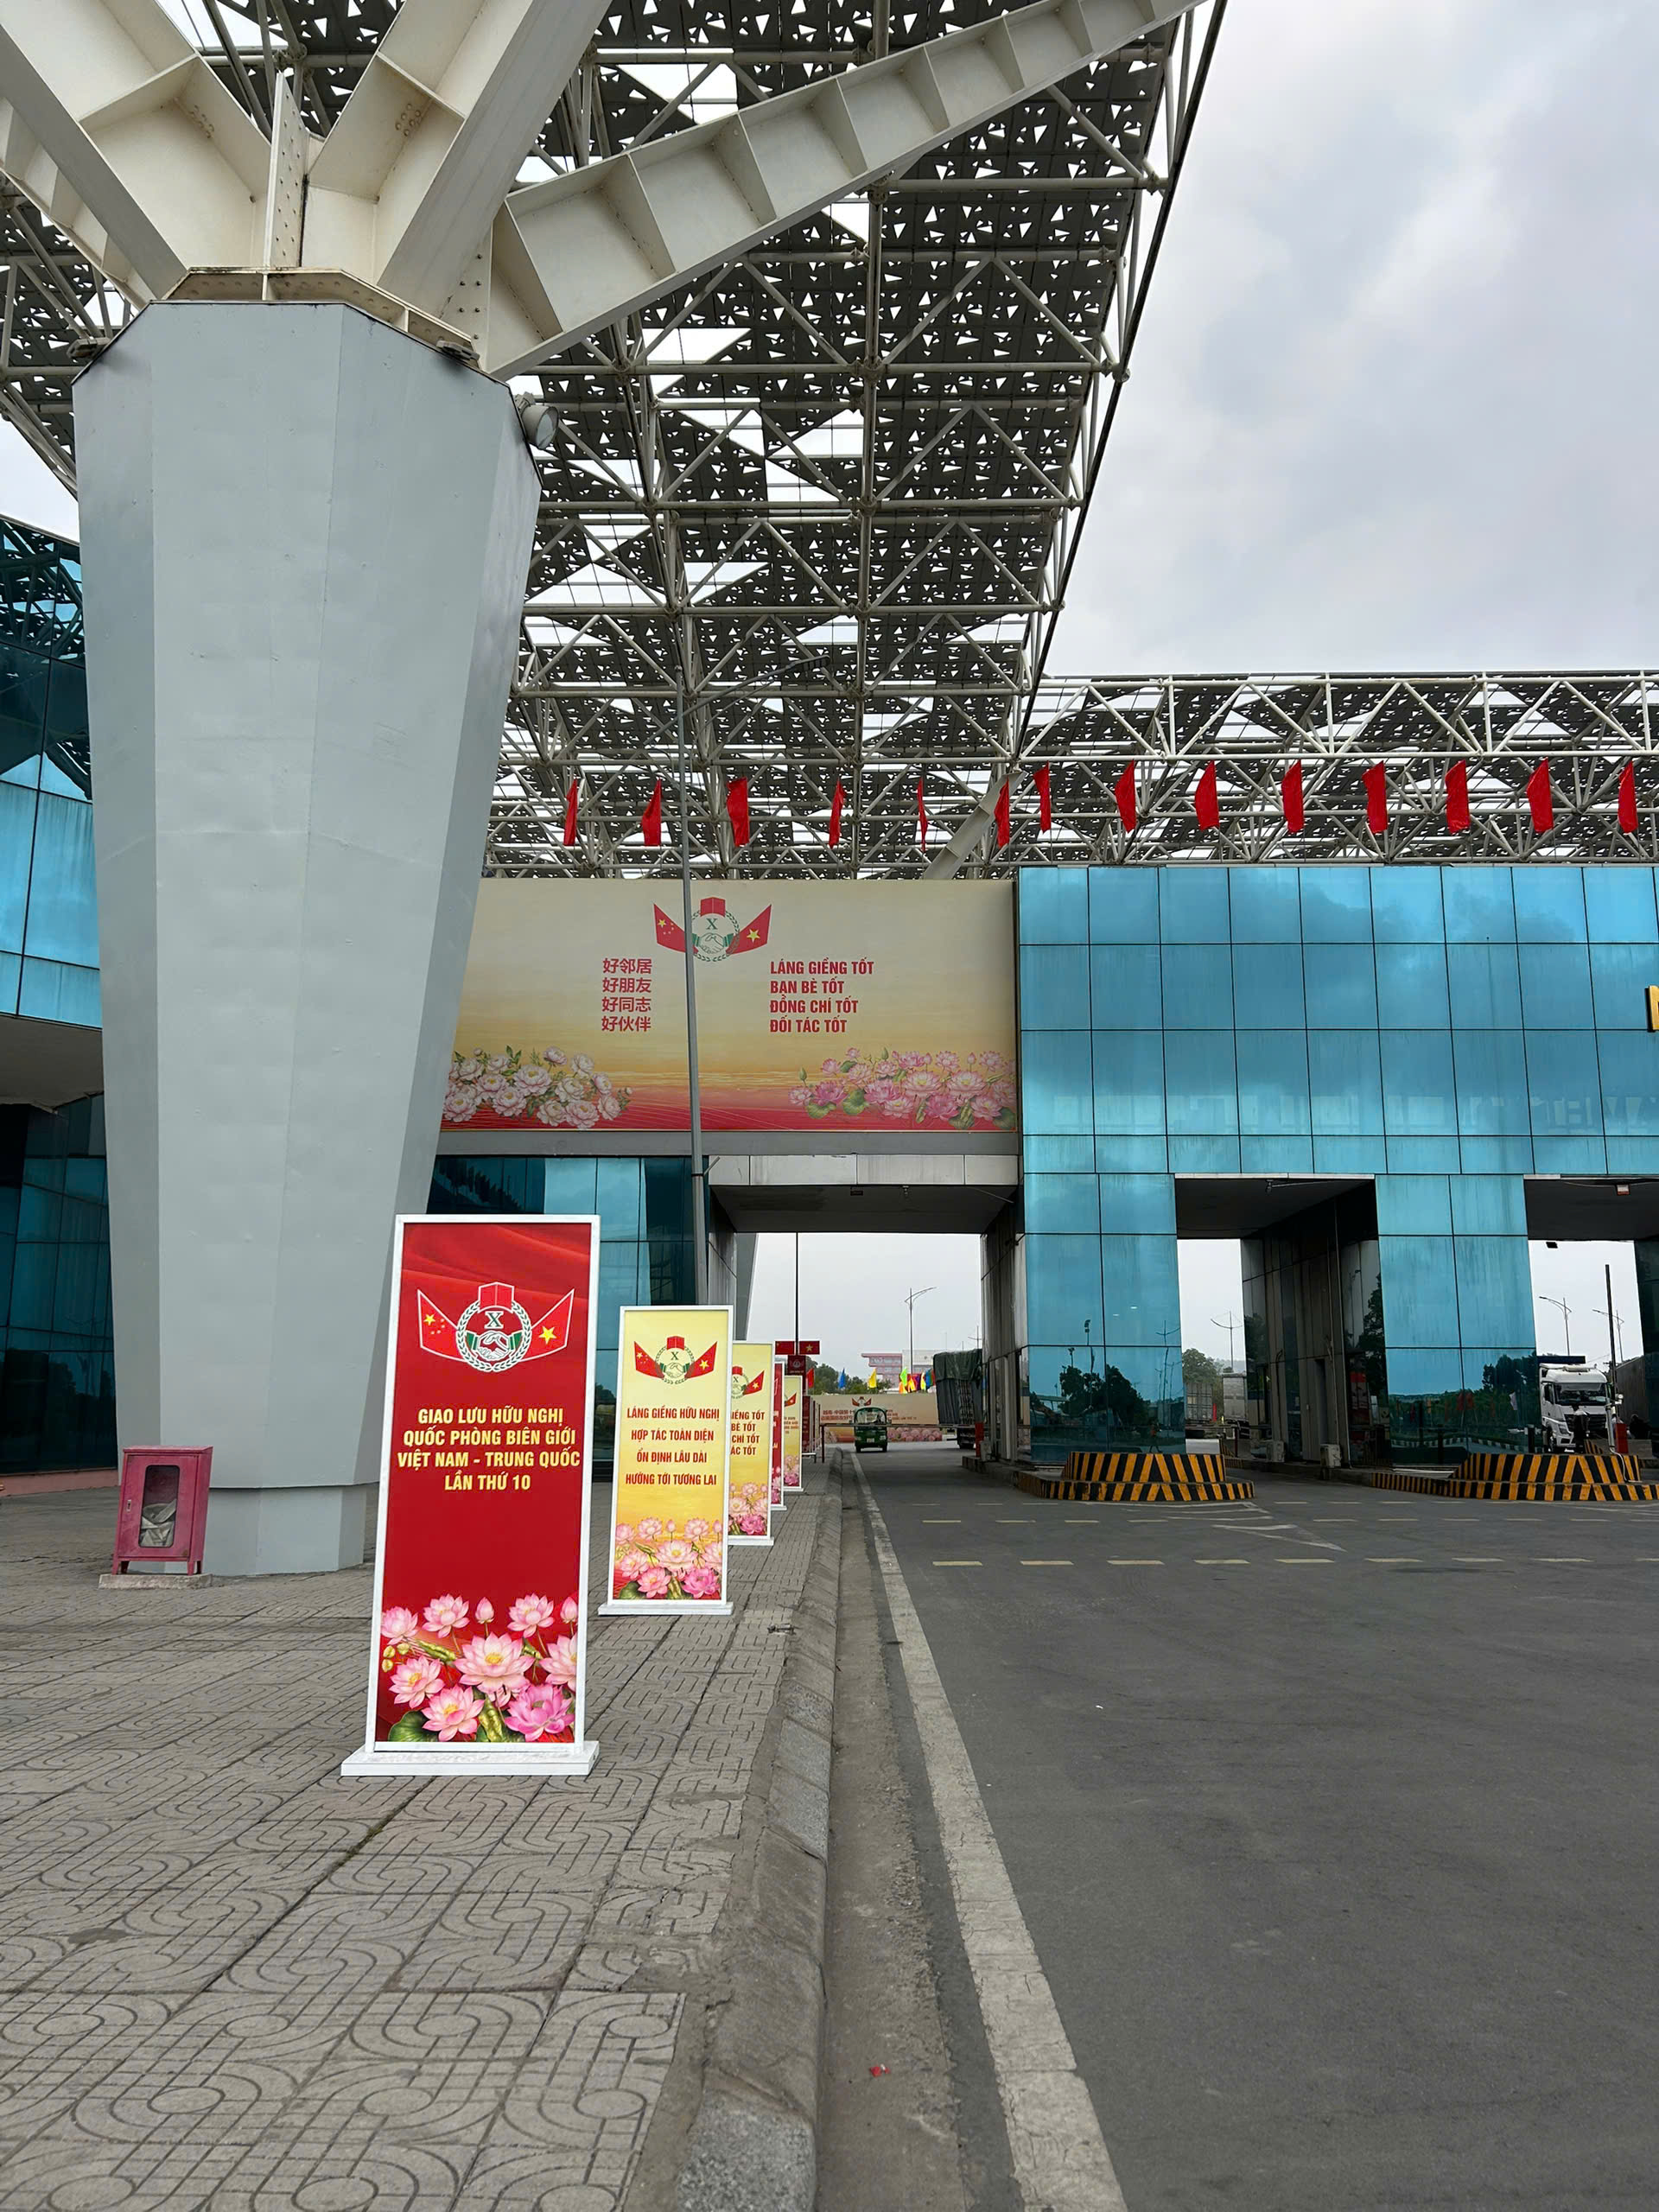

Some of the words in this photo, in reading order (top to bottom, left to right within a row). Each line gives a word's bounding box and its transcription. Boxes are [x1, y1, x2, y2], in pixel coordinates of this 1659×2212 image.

[705, 918, 718, 930] X
[602, 957, 652, 975] 好邻居
[770, 958, 804, 975] LÁNG
[851, 957, 874, 975] TỐT
[602, 977, 652, 994] 好朋友
[801, 978, 818, 994] BÈ
[821, 976, 845, 994] TỐT
[601, 996, 652, 1013] 好同志
[769, 995, 806, 1014] ĐỒNG
[810, 997, 832, 1014] CHÍ
[835, 995, 859, 1014] TỐT
[601, 1015, 652, 1033] 好伙伴
[769, 1015, 792, 1033] ĐỐI
[796, 1016, 821, 1033] TÁC
[823, 1015, 848, 1033] TỐT
[484, 1310, 505, 1330] X
[417, 1408, 454, 1425] GIAO
[458, 1406, 487, 1424] LƯU
[491, 1405, 524, 1424] HỮU
[527, 1408, 564, 1427] NGHỊ
[626, 1406, 649, 1419] LÁNG
[699, 1408, 720, 1421] NGHỊ
[752, 1409, 766, 1421] TỐT
[743, 1421, 757, 1432] TỐT
[403, 1425, 446, 1446] QUỐC
[450, 1427, 502, 1446] PHÒNG
[505, 1427, 541, 1446] BIÊN
[545, 1426, 576, 1446] GIỚI
[631, 1429, 649, 1443] HỢP
[651, 1427, 667, 1440] TÁC
[670, 1427, 692, 1440] TOÀN
[694, 1429, 715, 1444] DIỆN
[747, 1432, 760, 1444] TỐT
[651, 1451, 672, 1465] ĐỊNH
[674, 1449, 690, 1463] LÂU
[692, 1449, 708, 1463] DÀI
[730, 1444, 741, 1455] ÁC
[743, 1444, 757, 1455] TỐT
[397, 1448, 431, 1471] VIỆT
[435, 1452, 469, 1467] NAM
[484, 1452, 535, 1467] TRUNG
[538, 1446, 581, 1468] QUỐC
[444, 1469, 474, 1491] LẦN
[477, 1471, 509, 1491] THỨ
[512, 1474, 531, 1490] 10
[626, 1472, 655, 1485] HƯỚNG
[658, 1472, 671, 1485] TỚI
[673, 1473, 702, 1485] TƯƠNG
[703, 1474, 717, 1485] LAI
